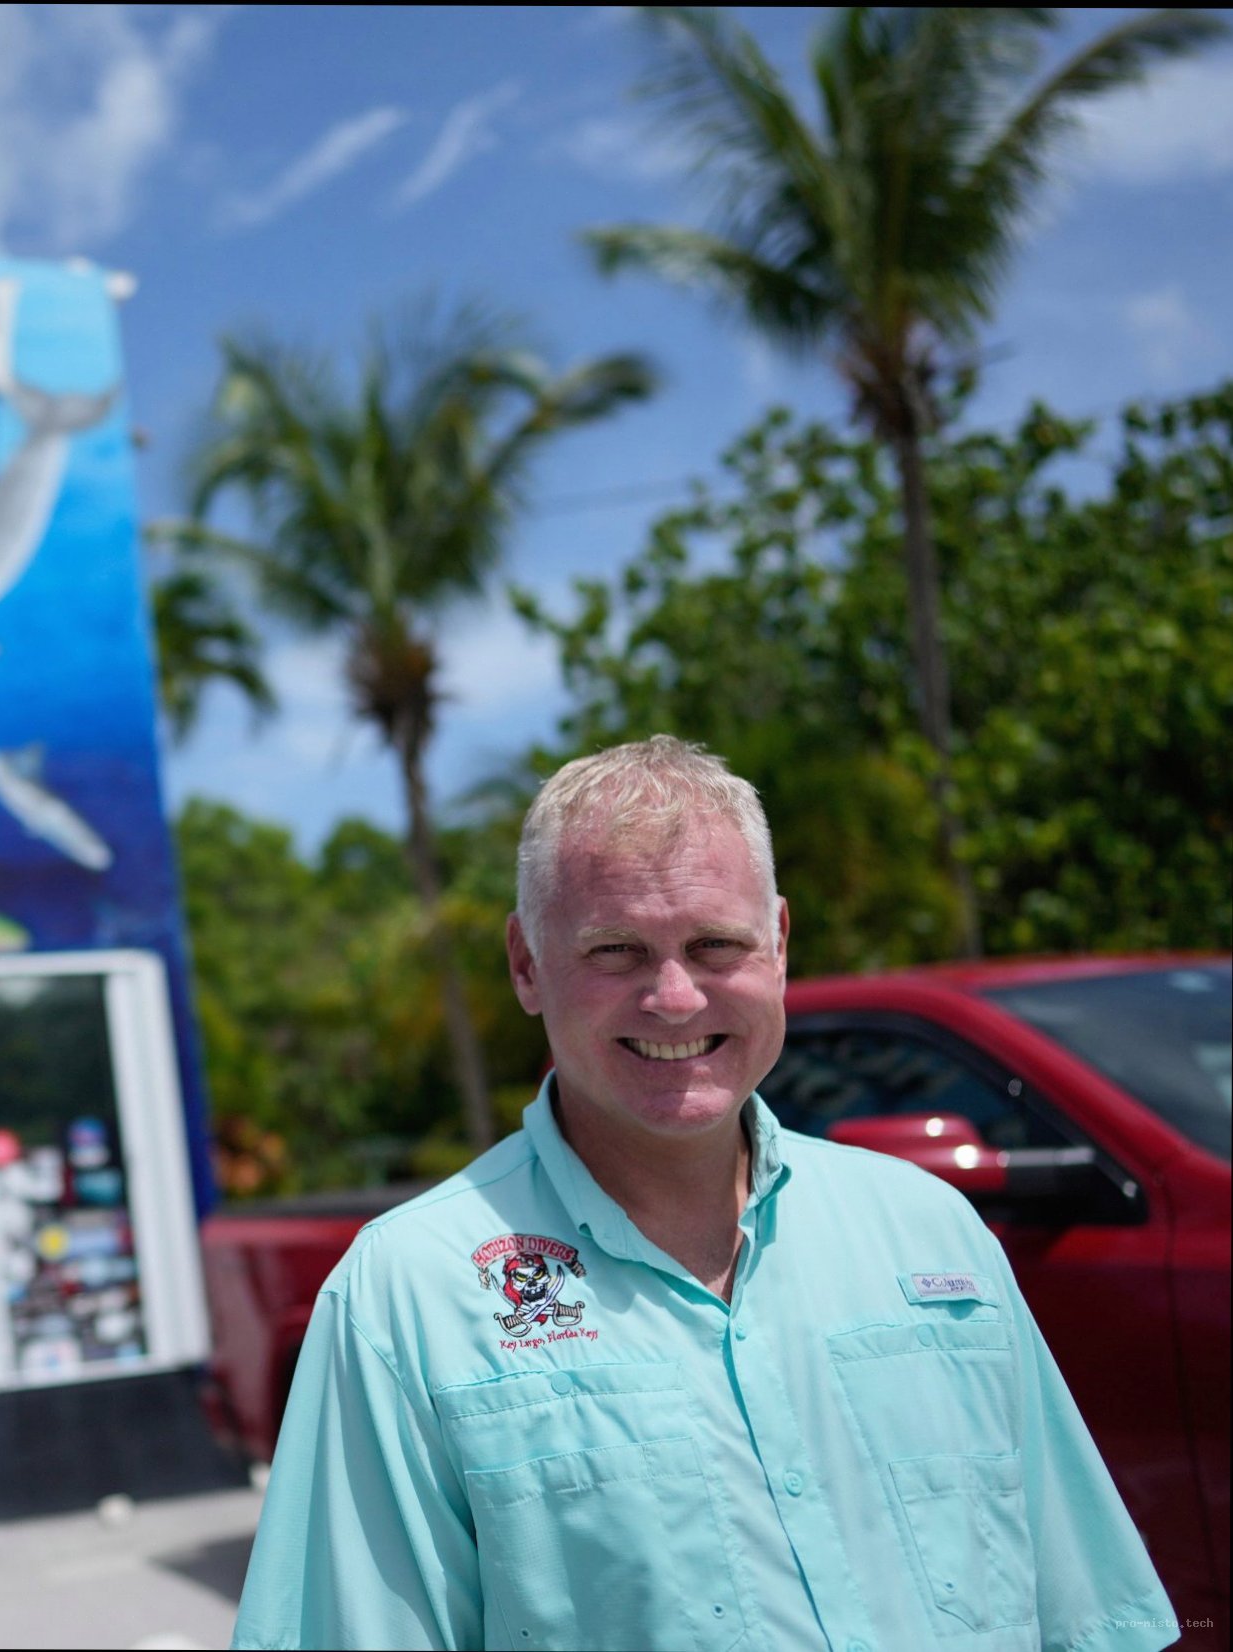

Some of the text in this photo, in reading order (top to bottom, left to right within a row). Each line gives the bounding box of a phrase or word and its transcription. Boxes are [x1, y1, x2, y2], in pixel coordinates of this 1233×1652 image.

[473, 1237, 574, 1265] HORIZON DIVERS
[499, 1340, 517, 1352] Key
[547, 1328, 578, 1343] Florida
